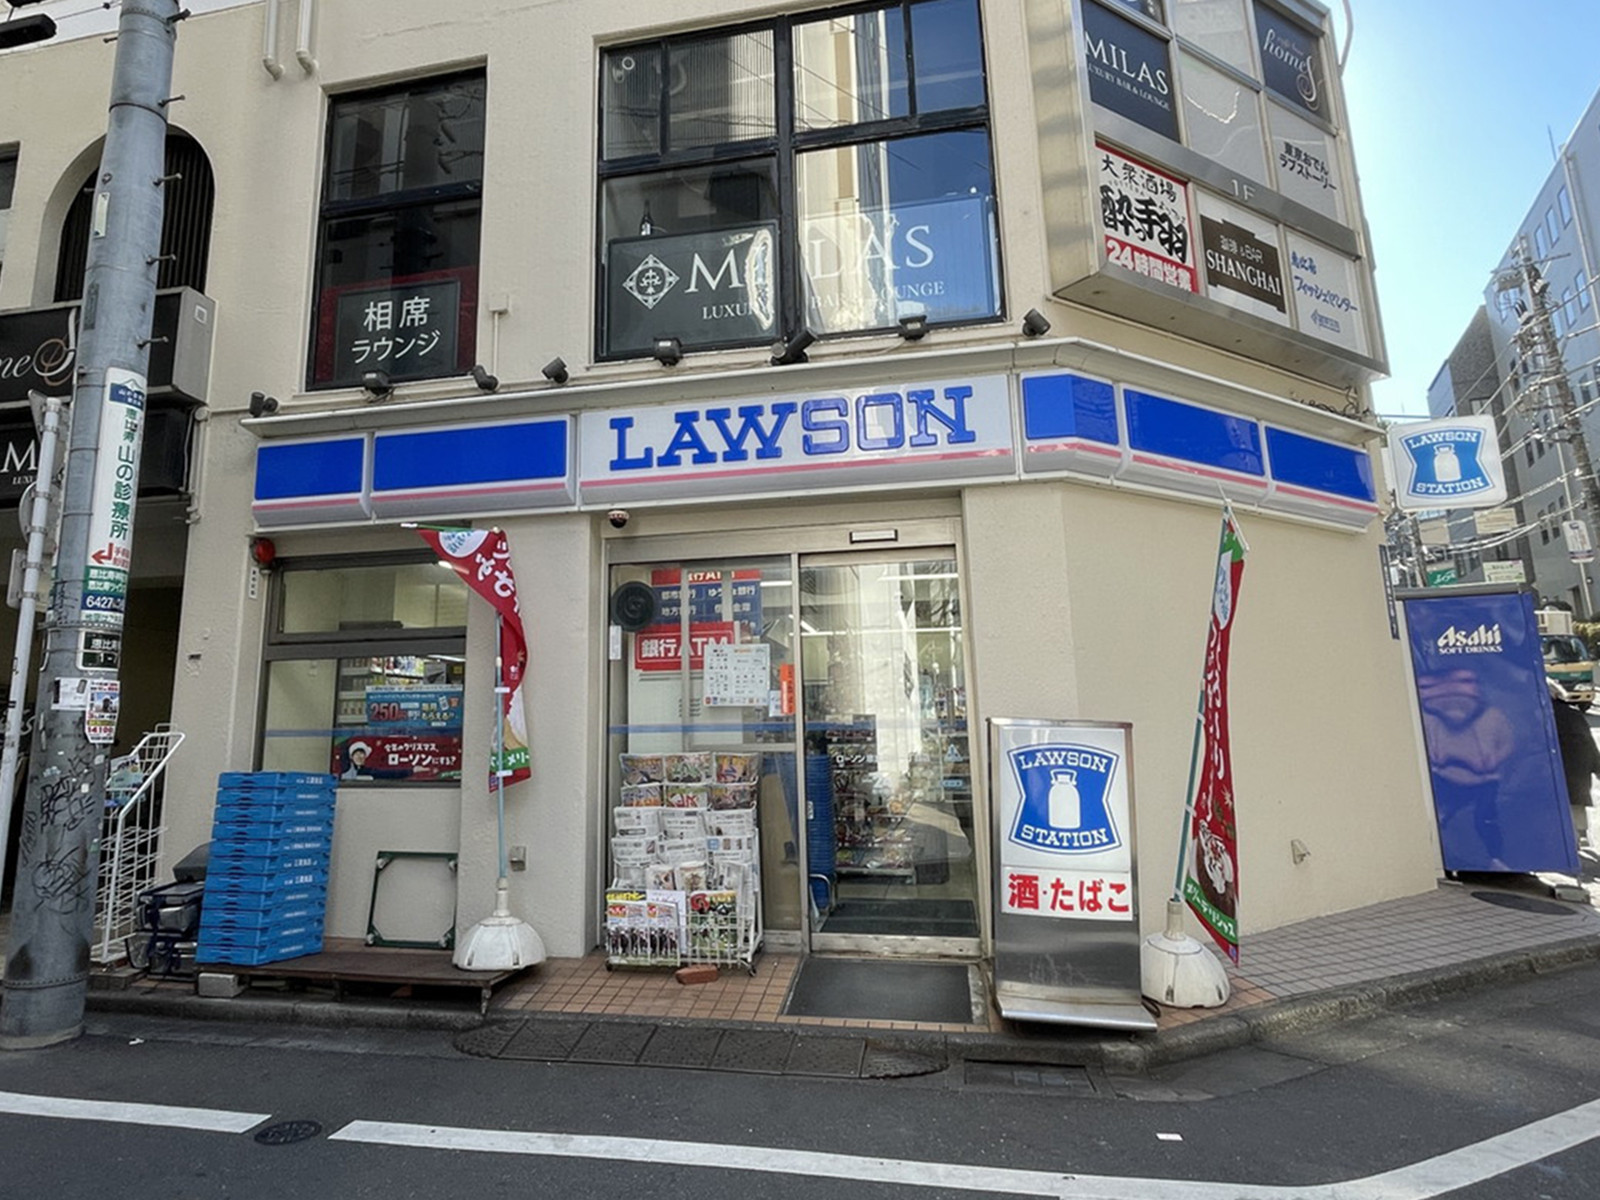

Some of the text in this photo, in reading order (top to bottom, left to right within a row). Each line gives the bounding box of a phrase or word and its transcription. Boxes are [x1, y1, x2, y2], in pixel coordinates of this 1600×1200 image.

[1085, 30, 1169, 96] MILAS
[1101, 154, 1177, 203] 大衆酒場
[1231, 179, 1256, 200] 1F
[1106, 239, 1192, 292] 24時間営業
[1205, 248, 1282, 297] SHANGHAI
[363, 295, 430, 332] 相席
[351, 329, 441, 364] ラウンジ
[609, 385, 976, 471] LAWSON
[1408, 431, 1478, 450] LAWSON
[109, 445, 135, 540] 山の診療所
[1416, 476, 1485, 495] STATION
[1437, 623, 1502, 648] Asahi
[1438, 645, 1503, 655] SOFT DRINKS
[1019, 752, 1108, 773] LAWSON
[1021, 824, 1108, 847] STATION
[1008, 873, 1130, 913] 酒・たばこ
